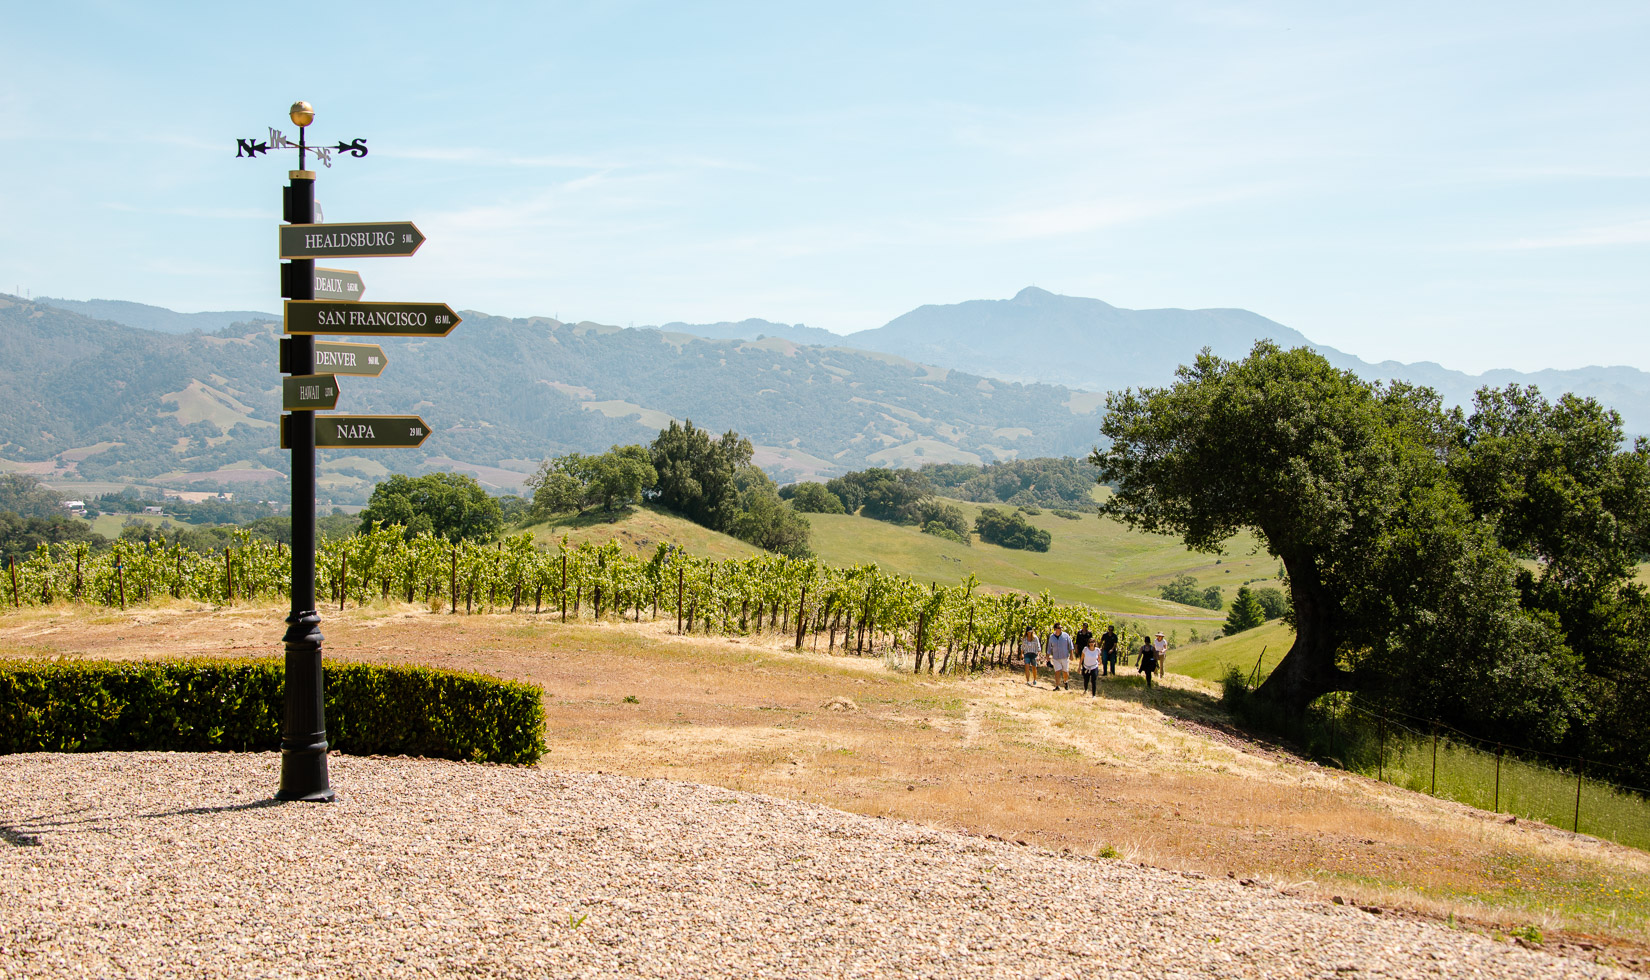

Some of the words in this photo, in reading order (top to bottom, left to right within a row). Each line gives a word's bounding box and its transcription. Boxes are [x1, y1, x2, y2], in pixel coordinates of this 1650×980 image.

[235, 138, 257, 158] N
[350, 138, 368, 158] S
[305, 231, 395, 249] HEALDSBURG
[402, 234, 406, 244] 5
[314, 277, 343, 293] DEAUX
[318, 310, 346, 325] SAN
[350, 311, 427, 327] FRANCISCO
[435, 315, 442, 324] 63
[442, 315, 451, 325] MI.
[316, 350, 357, 366] DENVER
[300, 385, 320, 400] HAWAII
[337, 424, 376, 439] NAPA
[409, 427, 415, 437] 29
